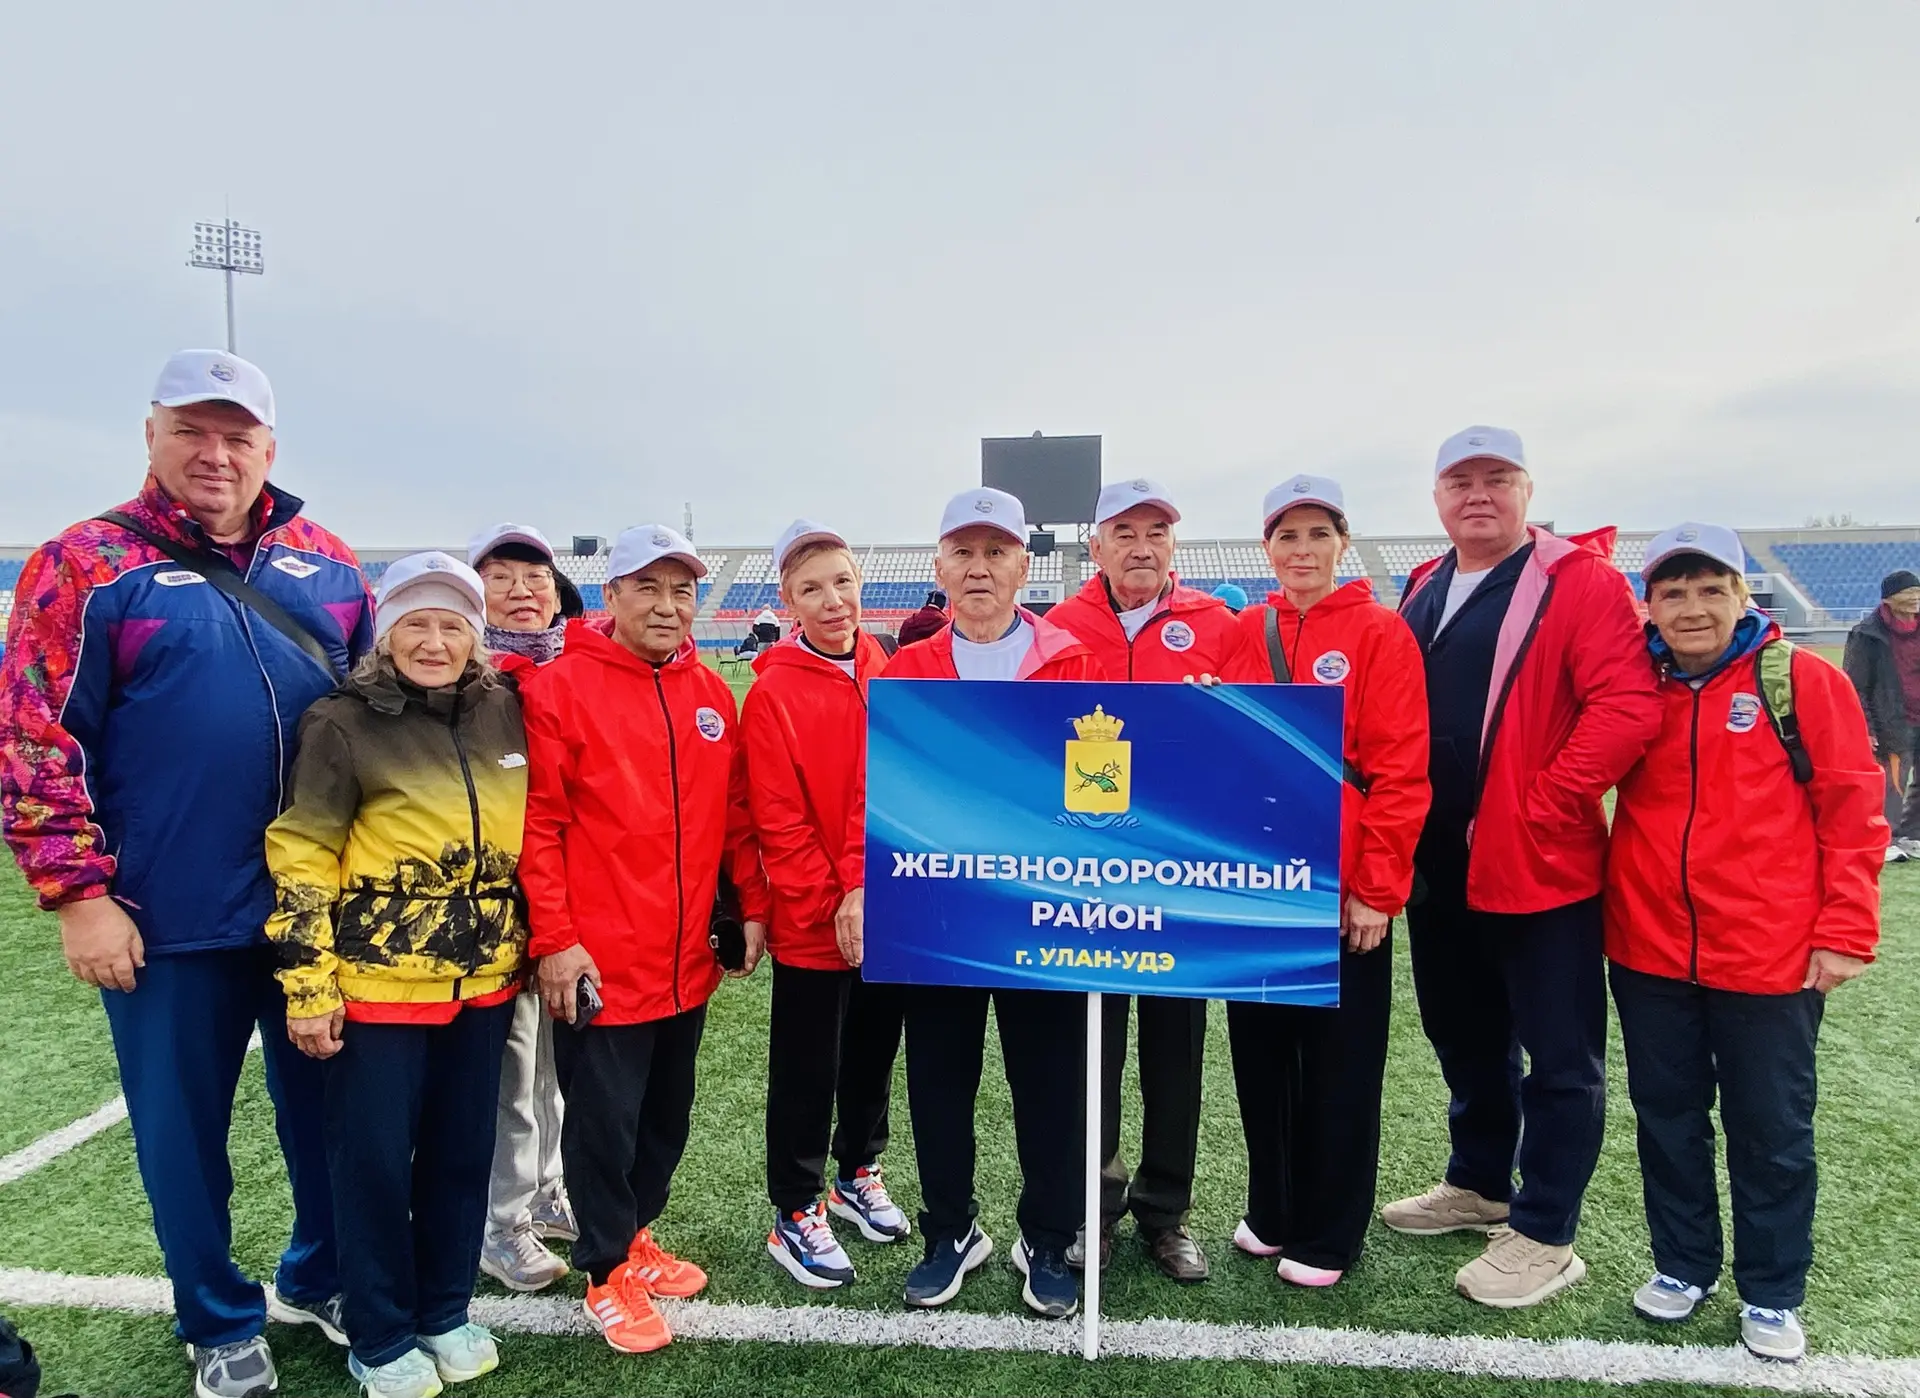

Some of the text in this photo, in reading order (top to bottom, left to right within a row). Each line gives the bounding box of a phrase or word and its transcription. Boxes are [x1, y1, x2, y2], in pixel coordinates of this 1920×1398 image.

[891, 852, 1311, 891] ЖЕЛЕЗНОДОРОЖНЫЙ
[1032, 897, 1162, 931] РАЙОН
[1015, 948, 1176, 974] г. УЛАН-УДЭ
